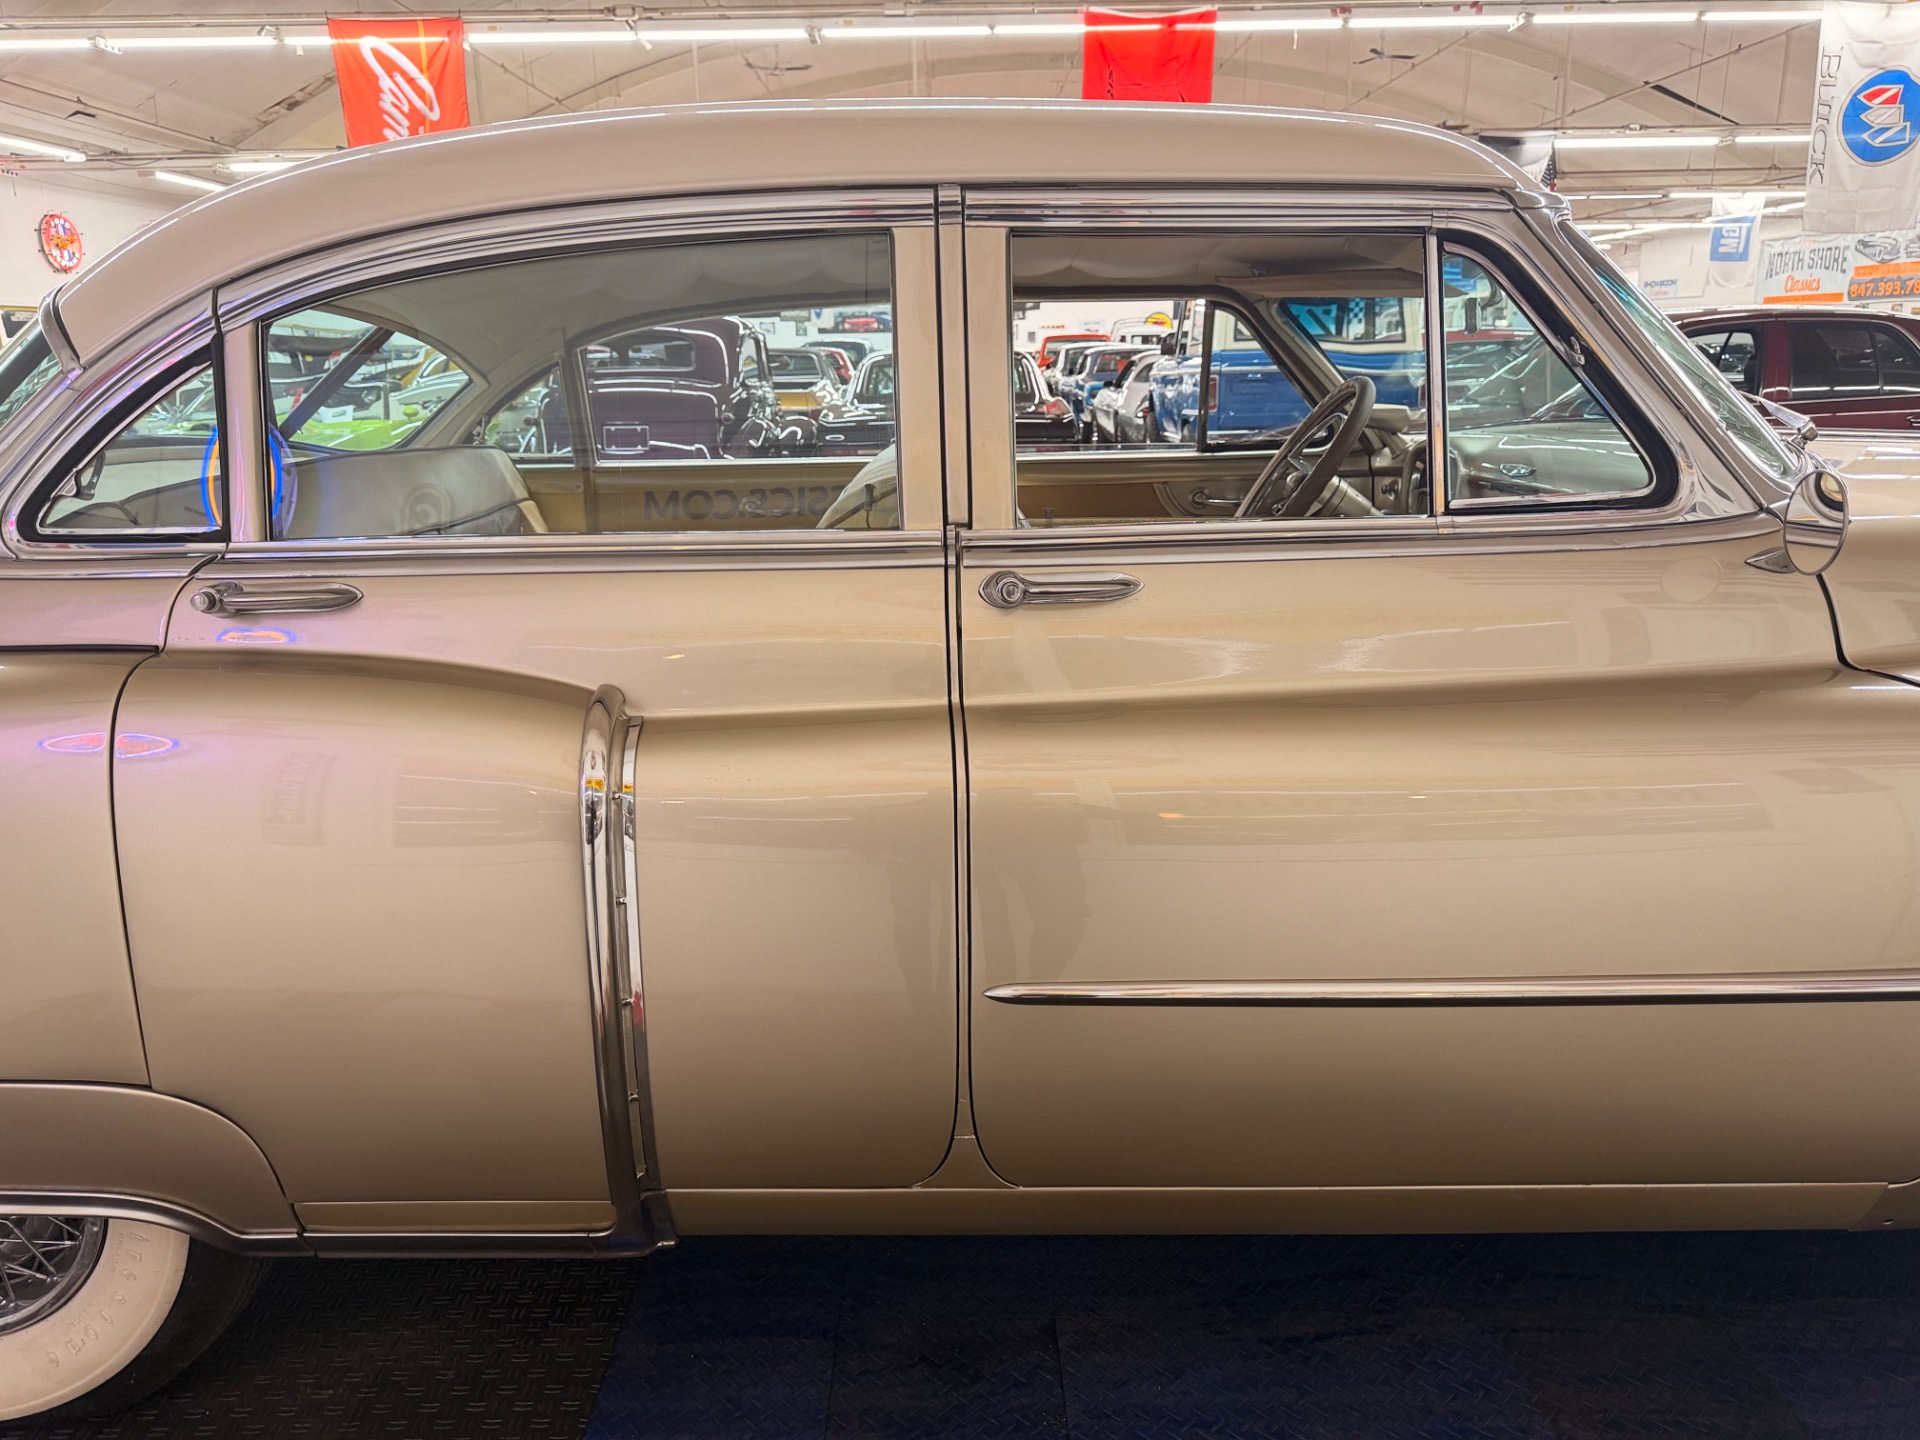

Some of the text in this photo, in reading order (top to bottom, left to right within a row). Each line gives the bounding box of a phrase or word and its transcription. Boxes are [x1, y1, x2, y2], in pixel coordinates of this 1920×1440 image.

[1809, 46, 1843, 184] BUICK
[1765, 249, 1805, 280] NORTH
[1807, 246, 1850, 274] SHORE
[1784, 273, 1821, 294] Classics
